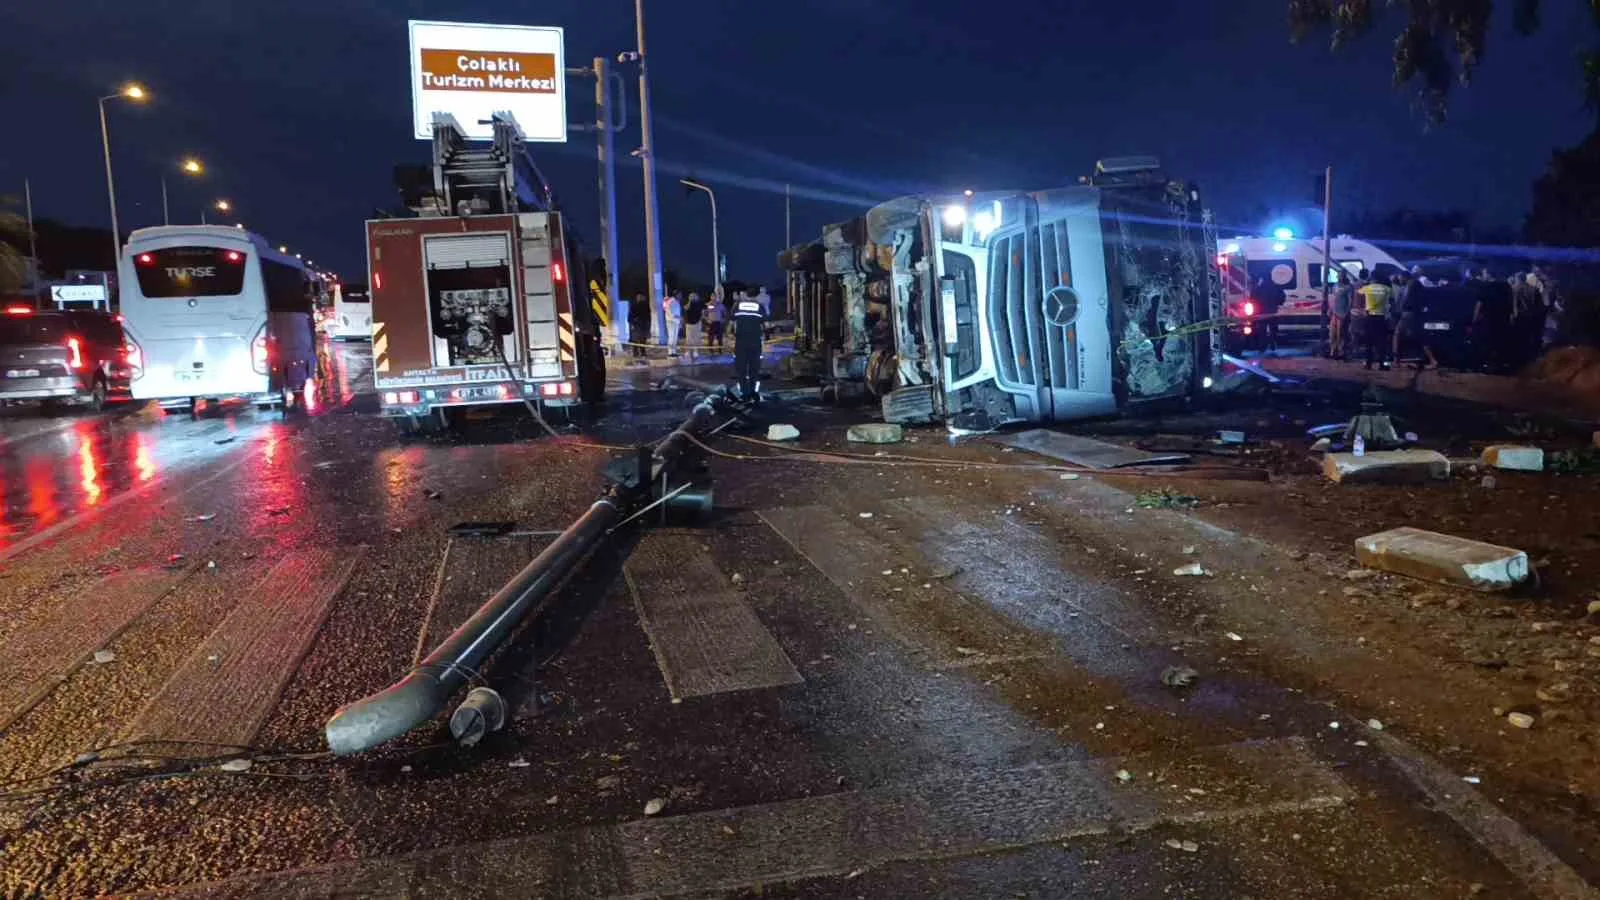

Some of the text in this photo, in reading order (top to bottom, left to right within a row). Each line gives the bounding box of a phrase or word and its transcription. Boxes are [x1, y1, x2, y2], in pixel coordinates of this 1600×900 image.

[457, 56, 520, 72] Çolaklı
[423, 72, 555, 90] Turizm Merkezi
